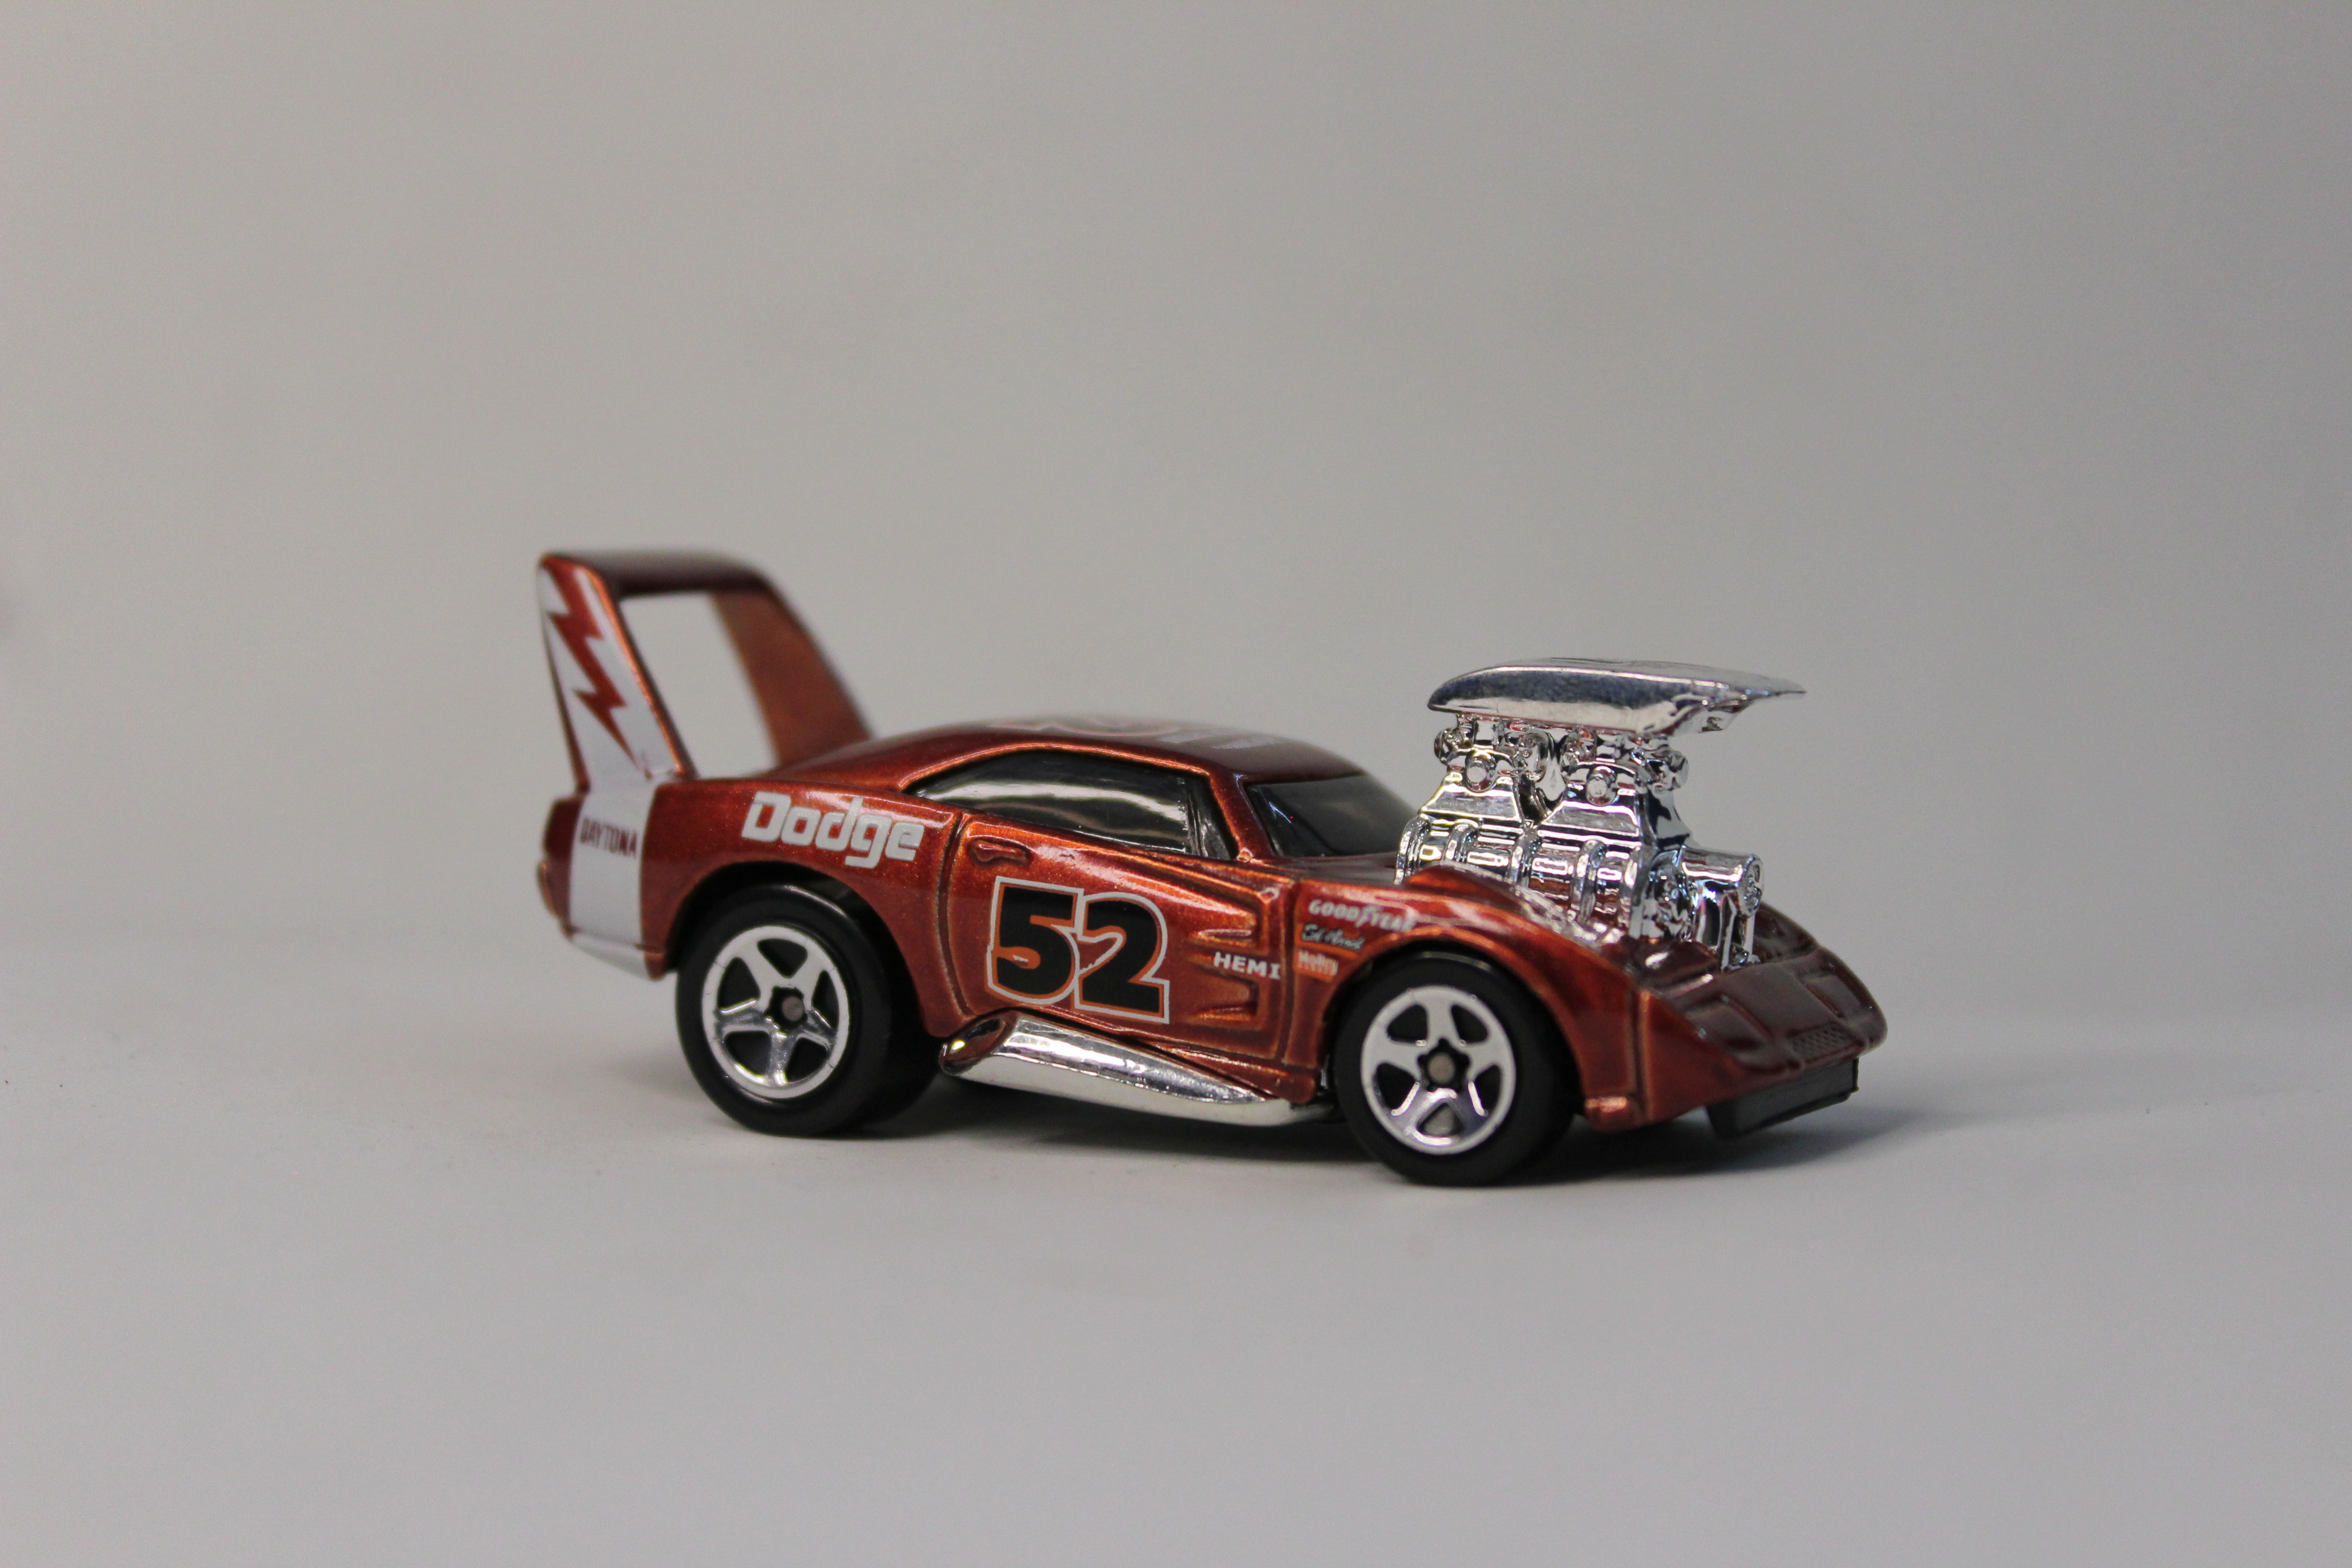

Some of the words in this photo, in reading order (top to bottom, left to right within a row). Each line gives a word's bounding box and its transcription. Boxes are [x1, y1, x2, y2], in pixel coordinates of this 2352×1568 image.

[580, 818, 637, 859] DAYTONA
[741, 791, 925, 868] Dodge
[1308, 899, 1416, 932] GOODYEAR
[987, 876, 1170, 1024] 52
[1213, 951, 1281, 980] HEMI
